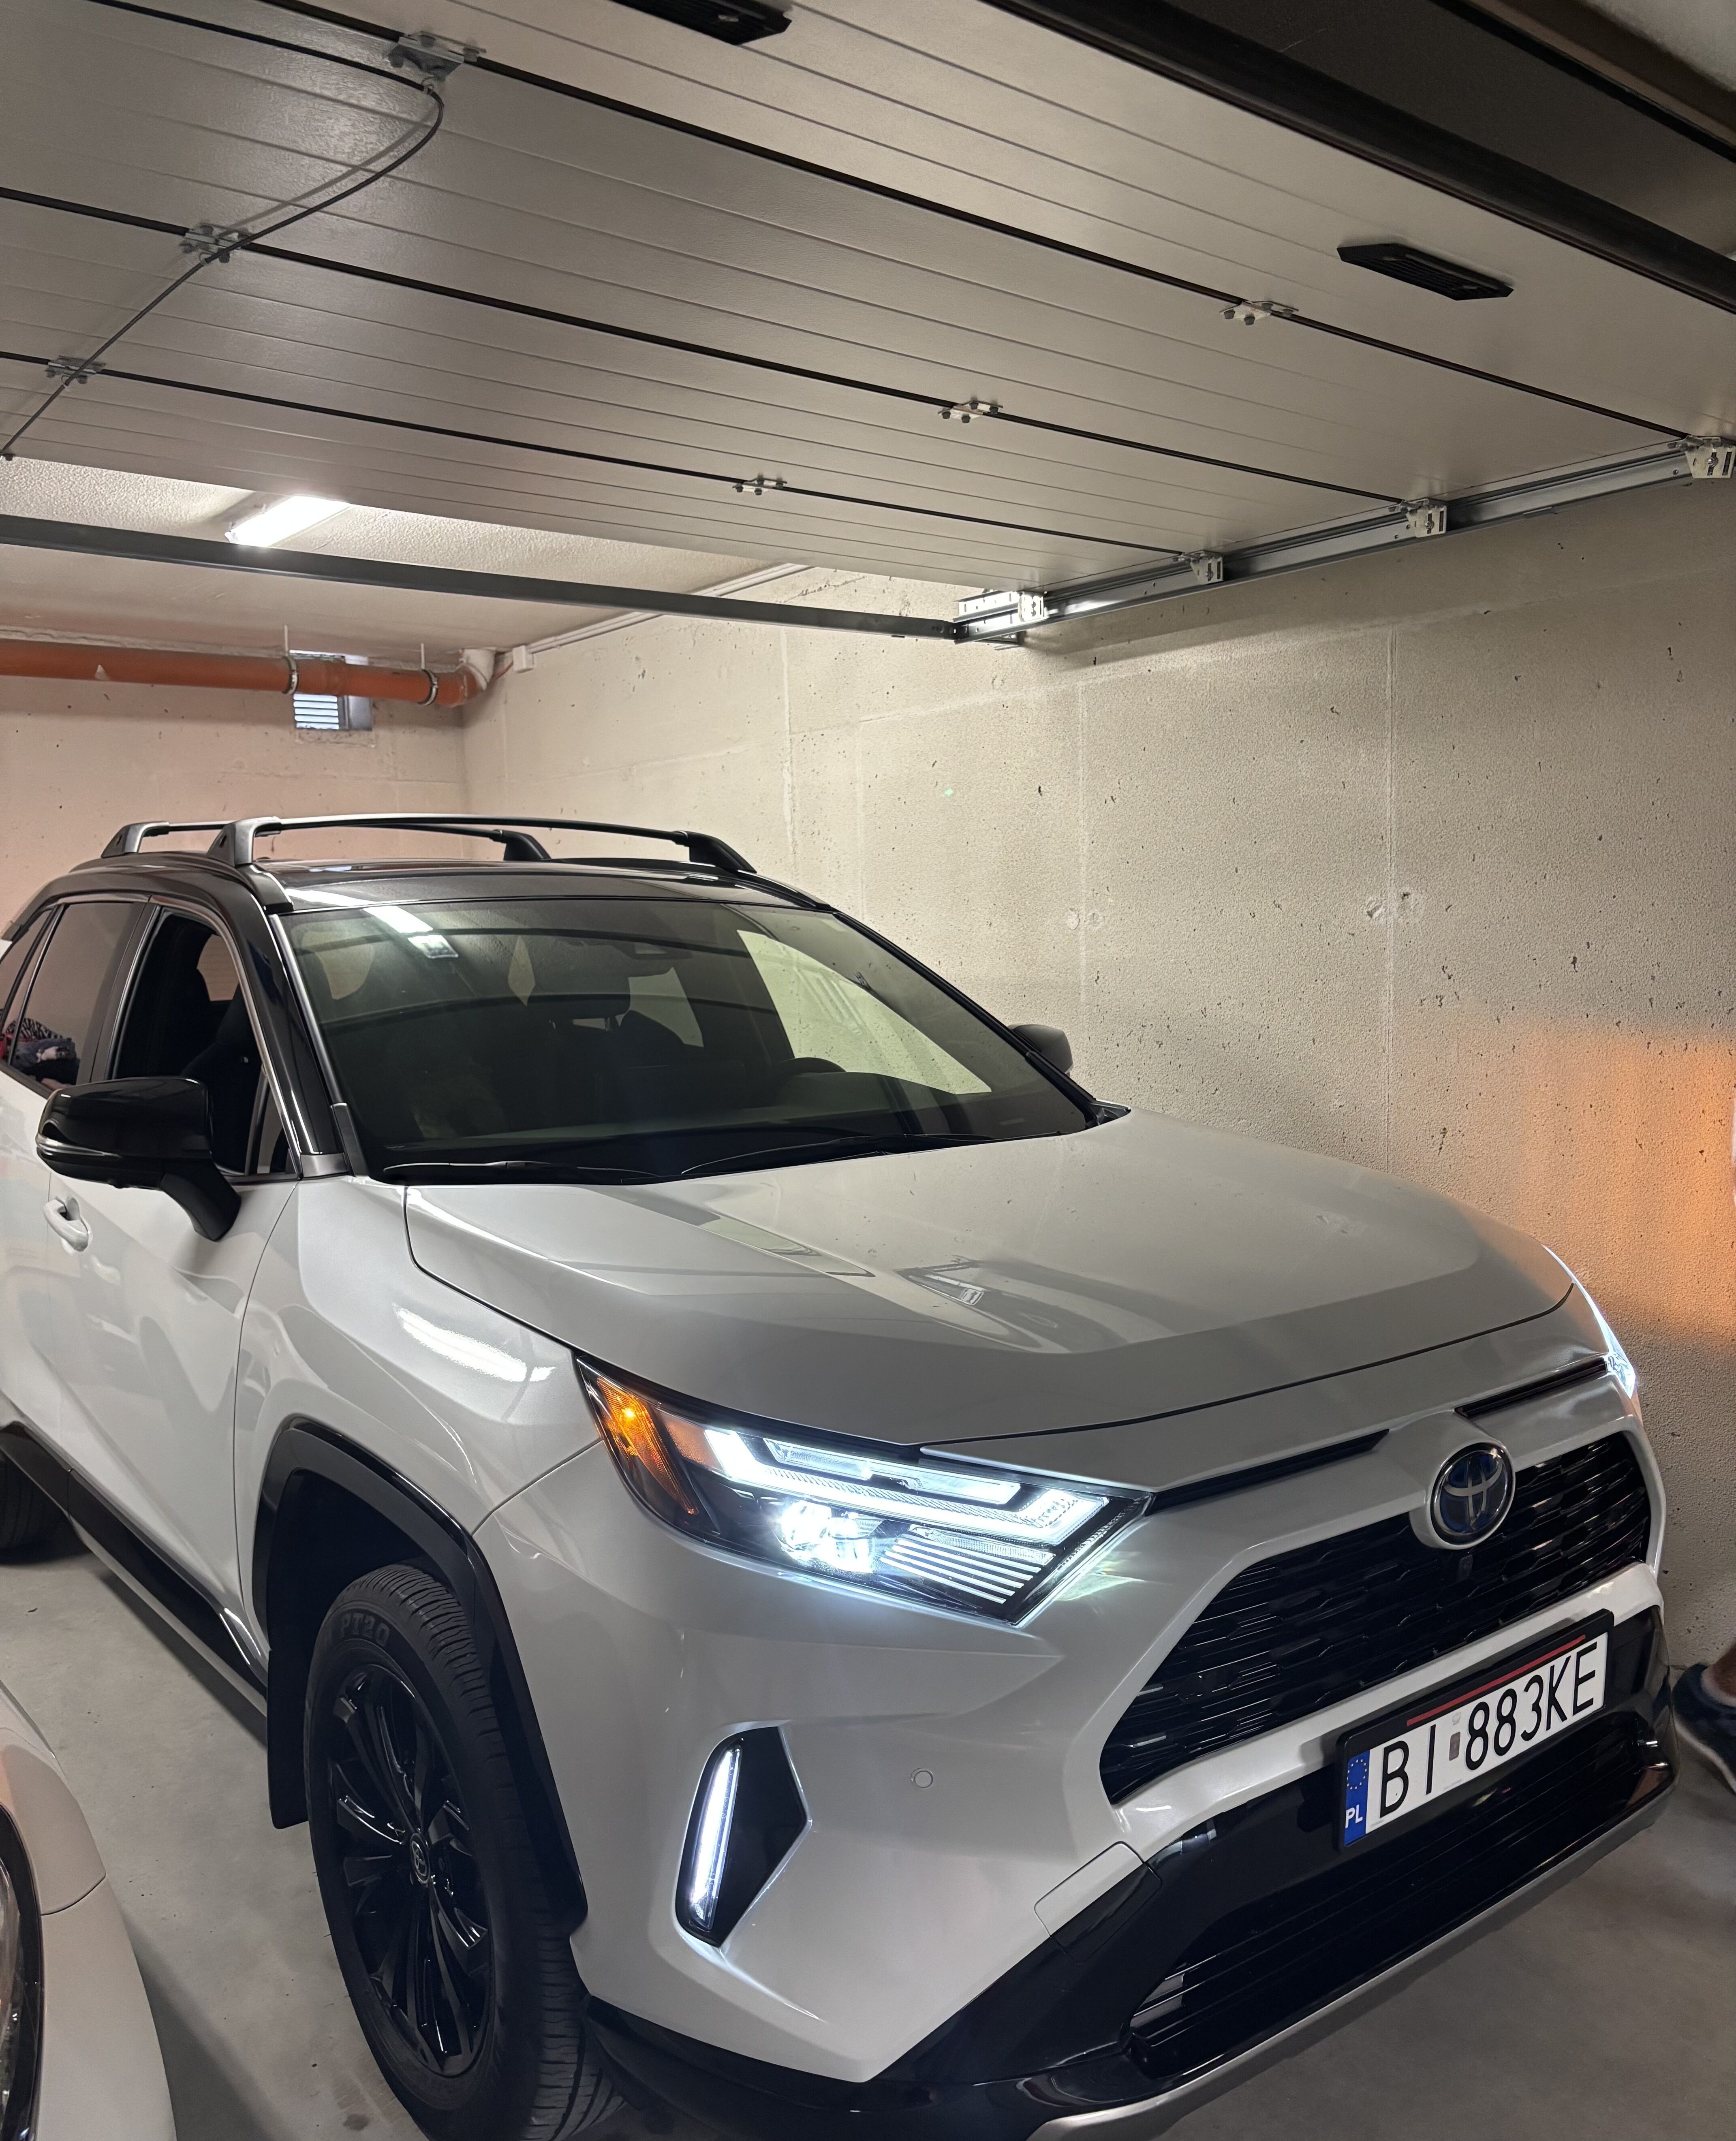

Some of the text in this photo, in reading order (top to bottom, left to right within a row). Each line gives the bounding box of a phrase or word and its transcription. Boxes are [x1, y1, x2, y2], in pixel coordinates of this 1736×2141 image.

[340, 1613, 390, 1647] PT20
[1379, 1641, 1597, 1818] BI 883KE
[1345, 1804, 1363, 1829] PL
